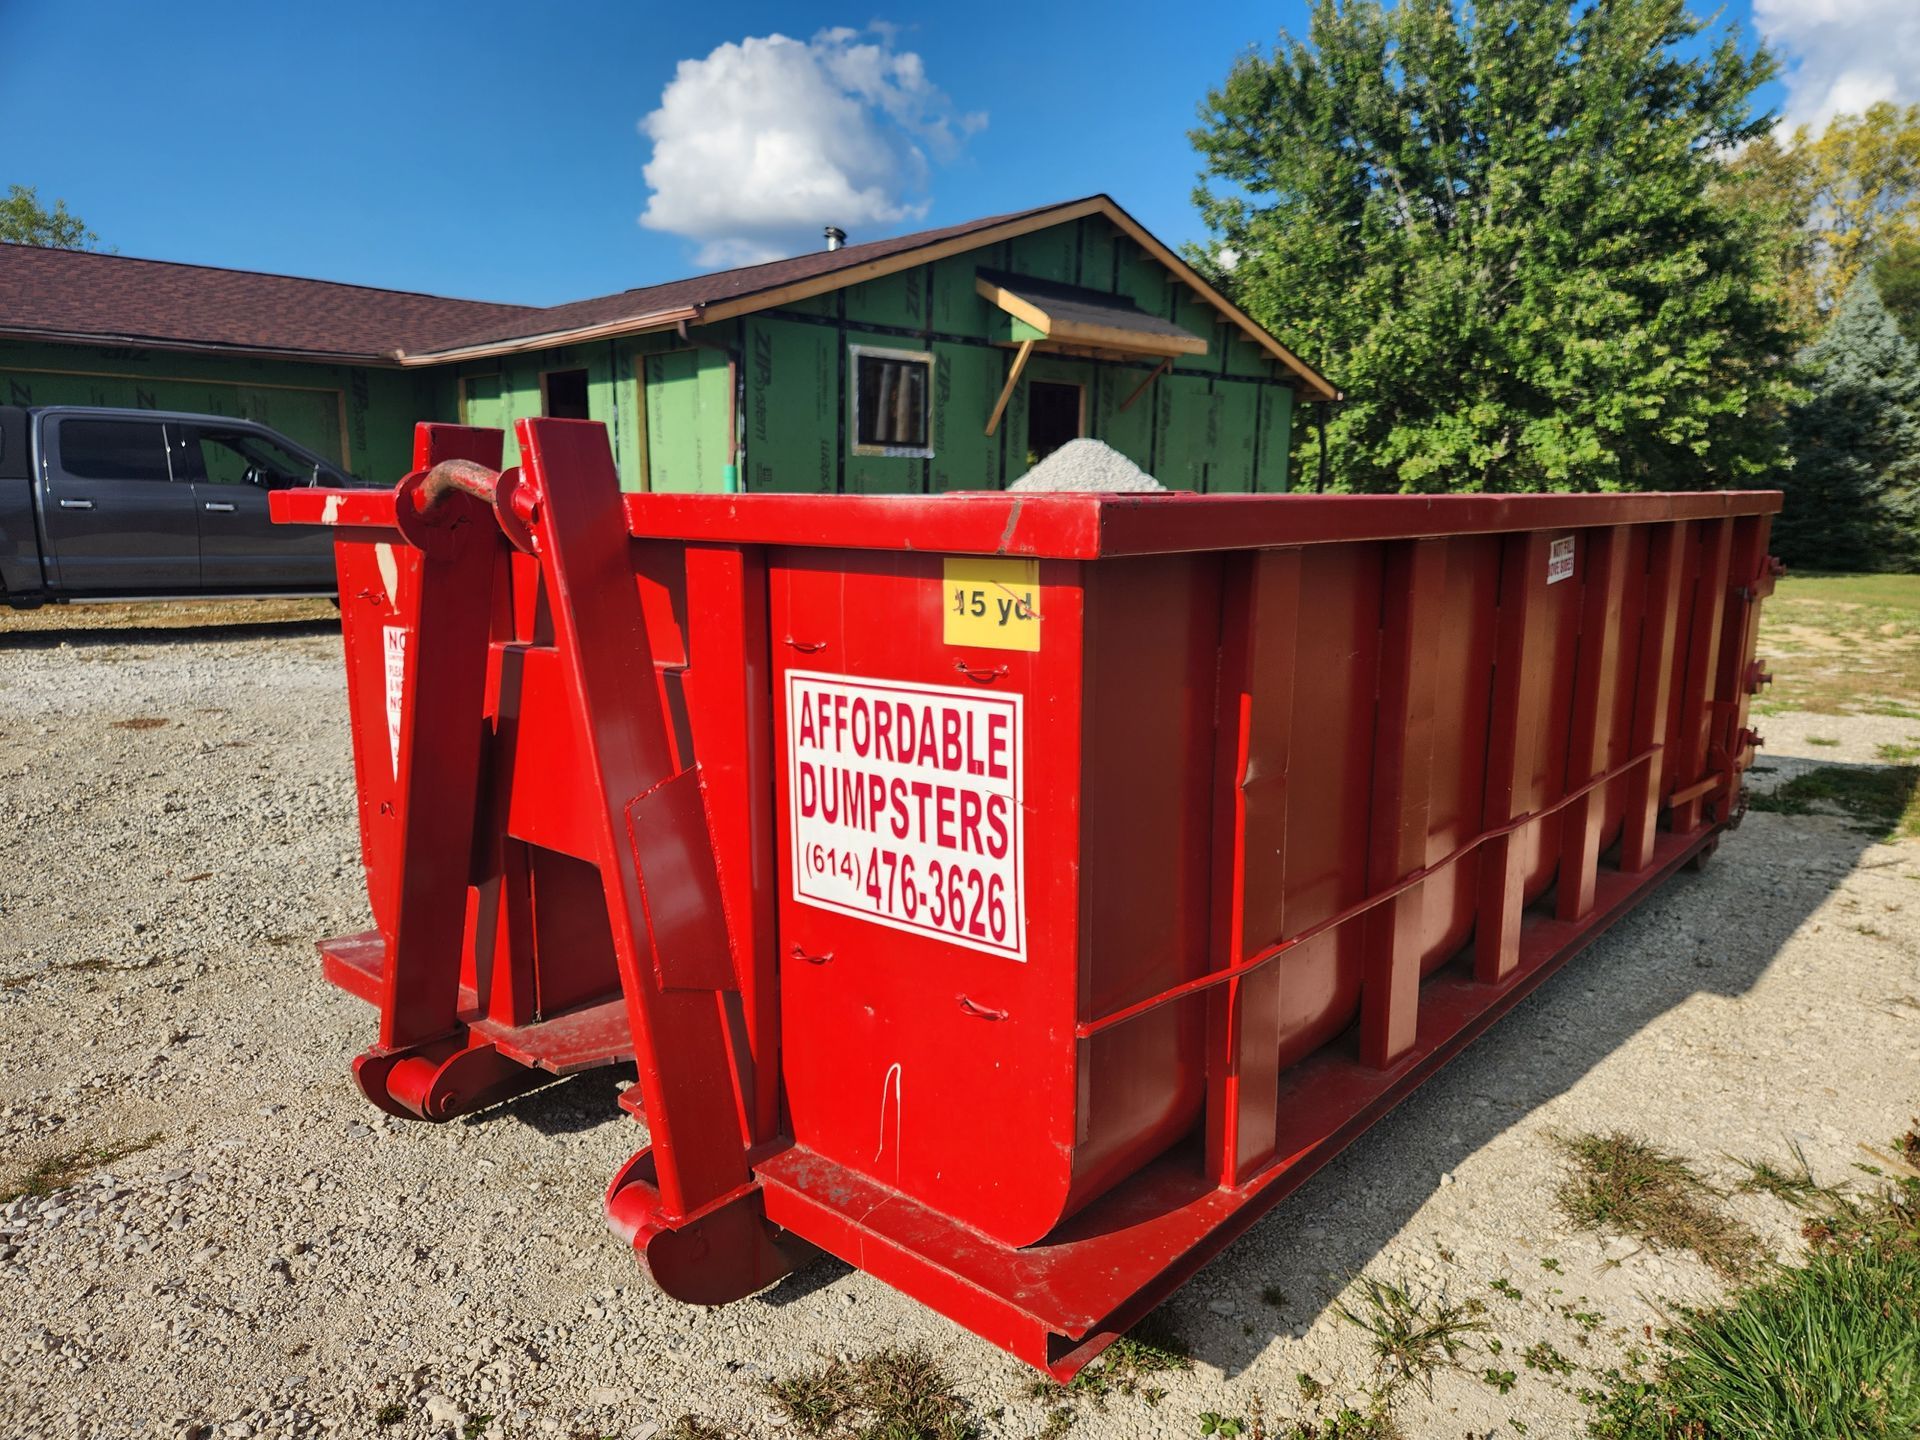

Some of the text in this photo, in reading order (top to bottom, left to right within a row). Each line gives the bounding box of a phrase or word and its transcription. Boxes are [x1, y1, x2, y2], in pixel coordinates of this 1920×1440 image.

[956, 590, 1032, 626] 15 yd
[800, 690, 1008, 779] AFFORDABLE
[800, 761, 1008, 860] DUMPSTERS
[805, 841, 1007, 942] (614) 476-3626
